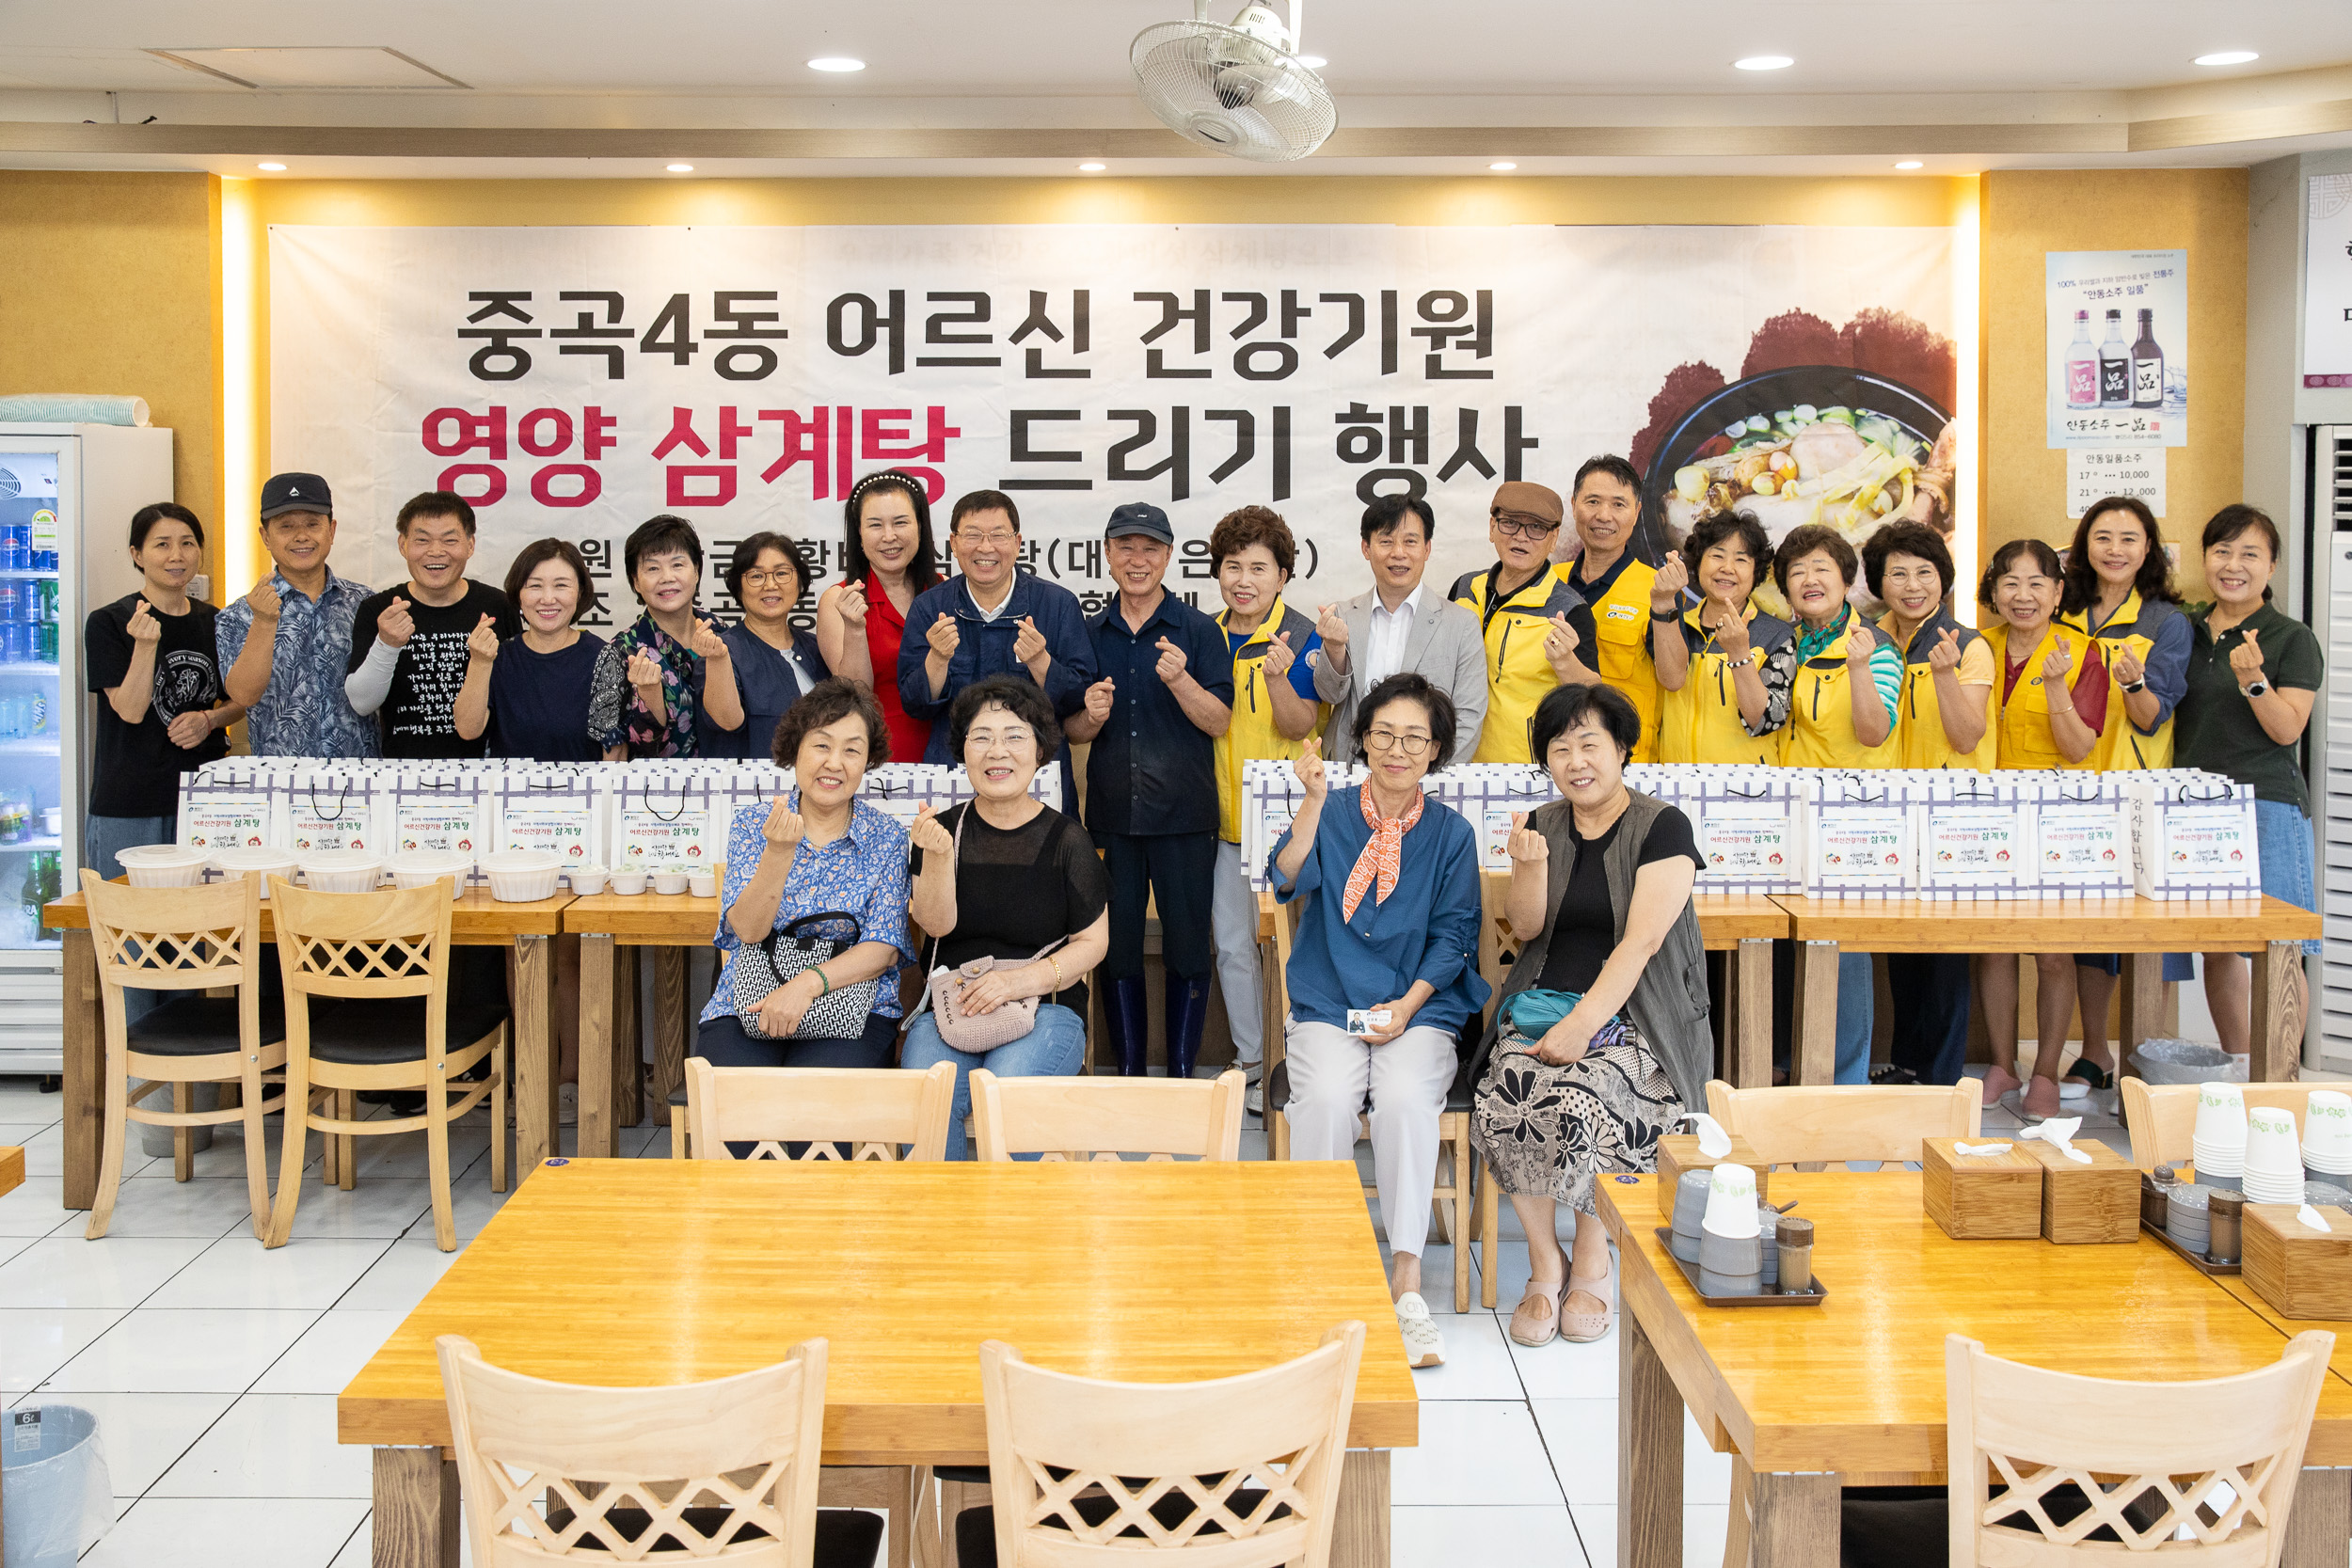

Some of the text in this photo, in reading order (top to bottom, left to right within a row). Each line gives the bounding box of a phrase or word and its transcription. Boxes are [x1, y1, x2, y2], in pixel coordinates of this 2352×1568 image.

[2058, 280, 2076, 289] 100%
[457, 289, 1494, 381] 중곡4동 어르신 건강기원
[2067, 419, 2111, 431] 안동소주
[421, 402, 1539, 508] 영양 삼계탕 드리기 행사
[2086, 453, 2142, 464] 안동일품소주
[2120, 471, 2150, 480] 10,000
[410, 633, 427, 641] 나는
[418, 641, 436, 652] 가장
[412, 652, 437, 662] 되기를
[419, 661, 463, 672] 오직 한없이
[406, 673, 432, 683] 가지고
[436, 673, 453, 682] 싶은
[412, 683, 437, 693] 문화의
[418, 693, 442, 704] 문화의
[233, 818, 260, 828] 삼계탕
[336, 822, 362, 831] 삼계탕
[443, 821, 469, 831] 삼계탕
[554, 827, 581, 836] 삼계탕
[672, 827, 700, 836] 삼계탕
[1981, 832, 2009, 841] 삼계탕
[2087, 831, 2113, 840] 삼계탕
[2131, 798, 2144, 875] 감사합니다
[2215, 832, 2239, 841] 삼계탕
[1754, 834, 1781, 844] 삼계탕
[1870, 835, 1898, 844] 삼계탕
